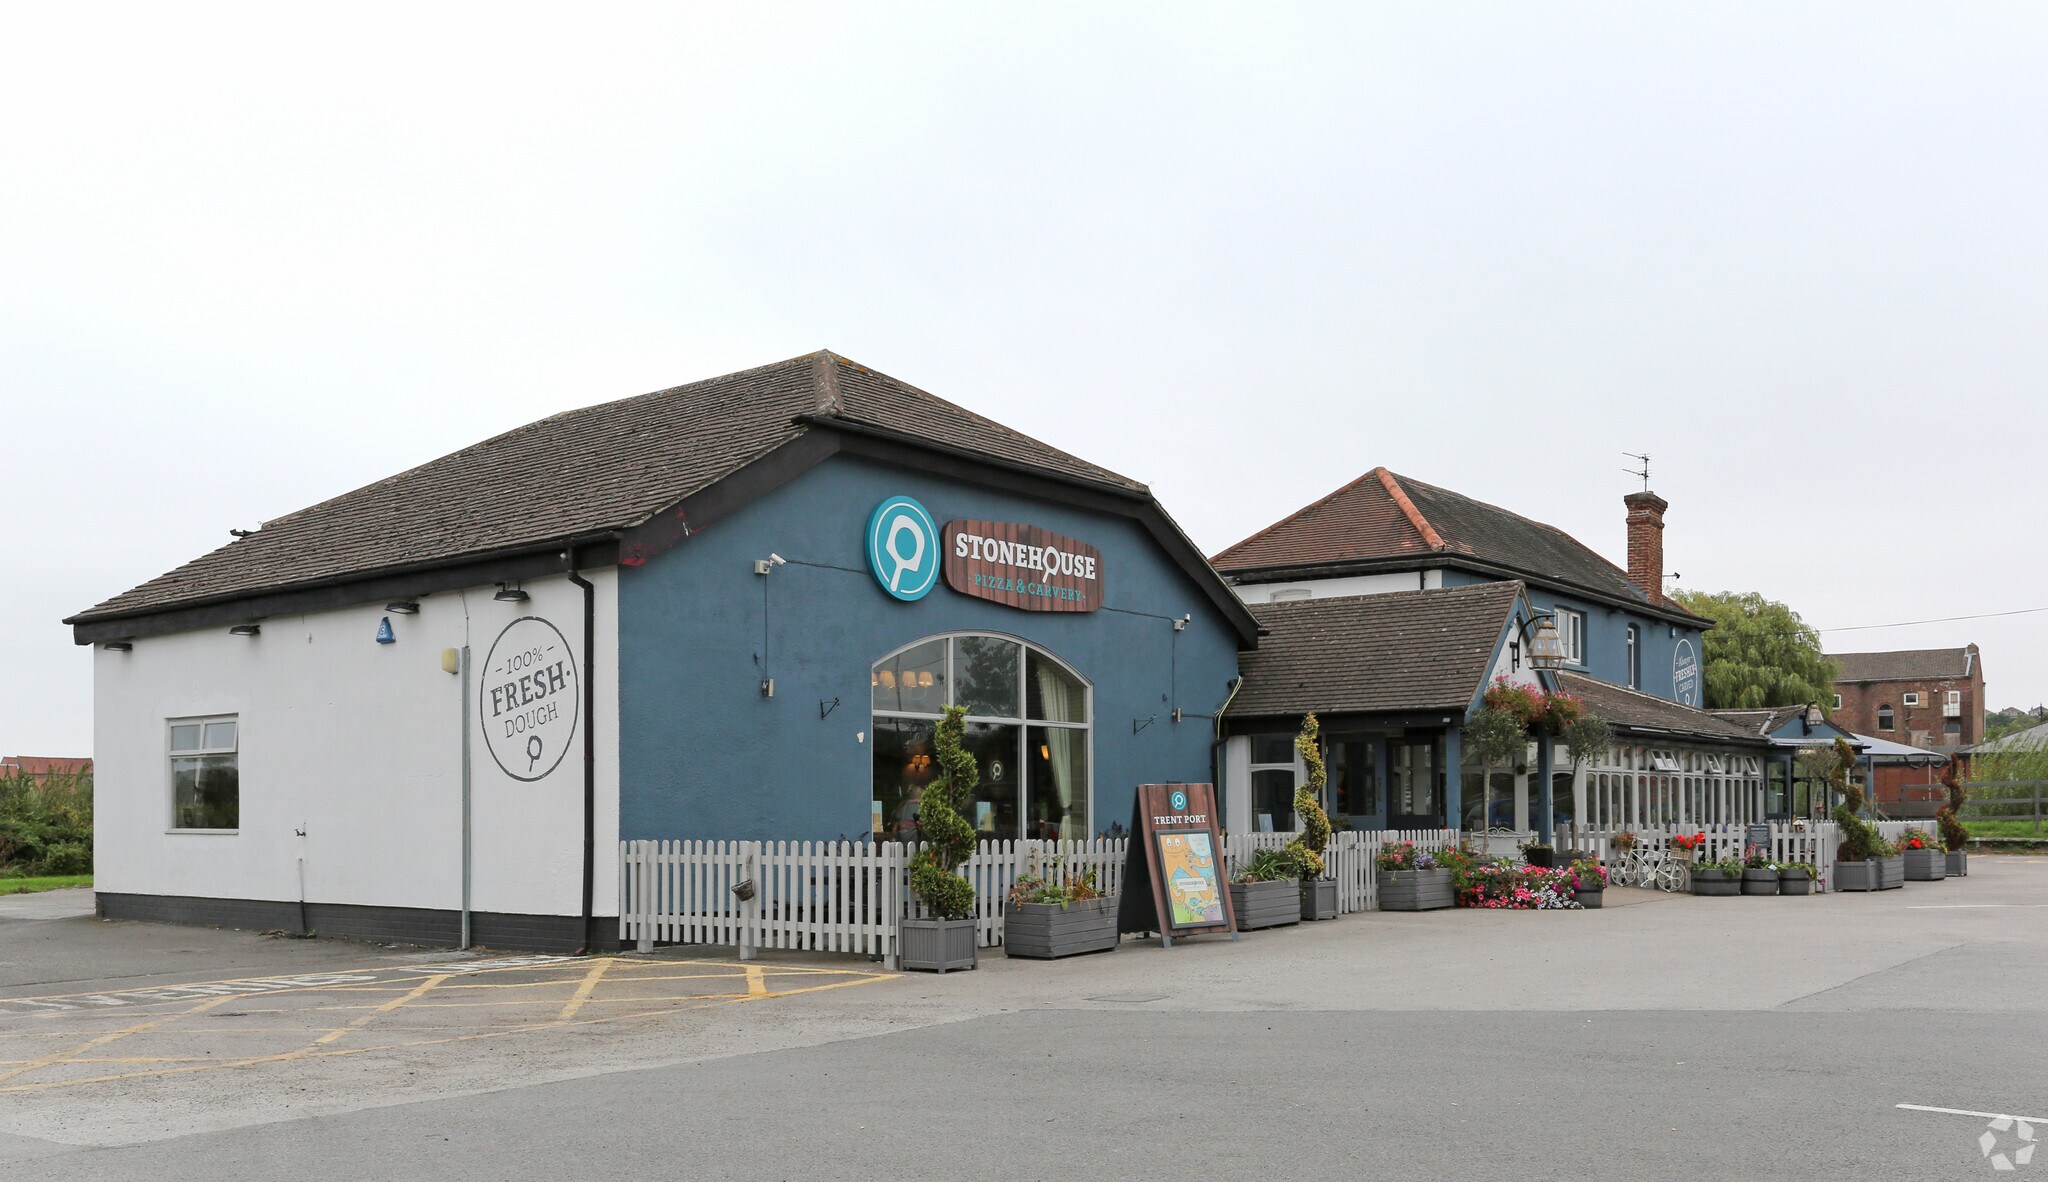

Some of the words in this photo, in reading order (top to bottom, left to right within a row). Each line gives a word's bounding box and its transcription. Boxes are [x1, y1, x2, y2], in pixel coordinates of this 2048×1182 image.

[956, 533, 1096, 584] STONEHOUSE
[975, 573, 1013, 592] PIZZA
[1016, 578, 1026, 594] &
[1028, 582, 1082, 602] CARVERY
[504, 702, 559, 739] DOUGH
[1154, 815, 1183, 825] TRENT
[1183, 814, 1206, 824] PORT
